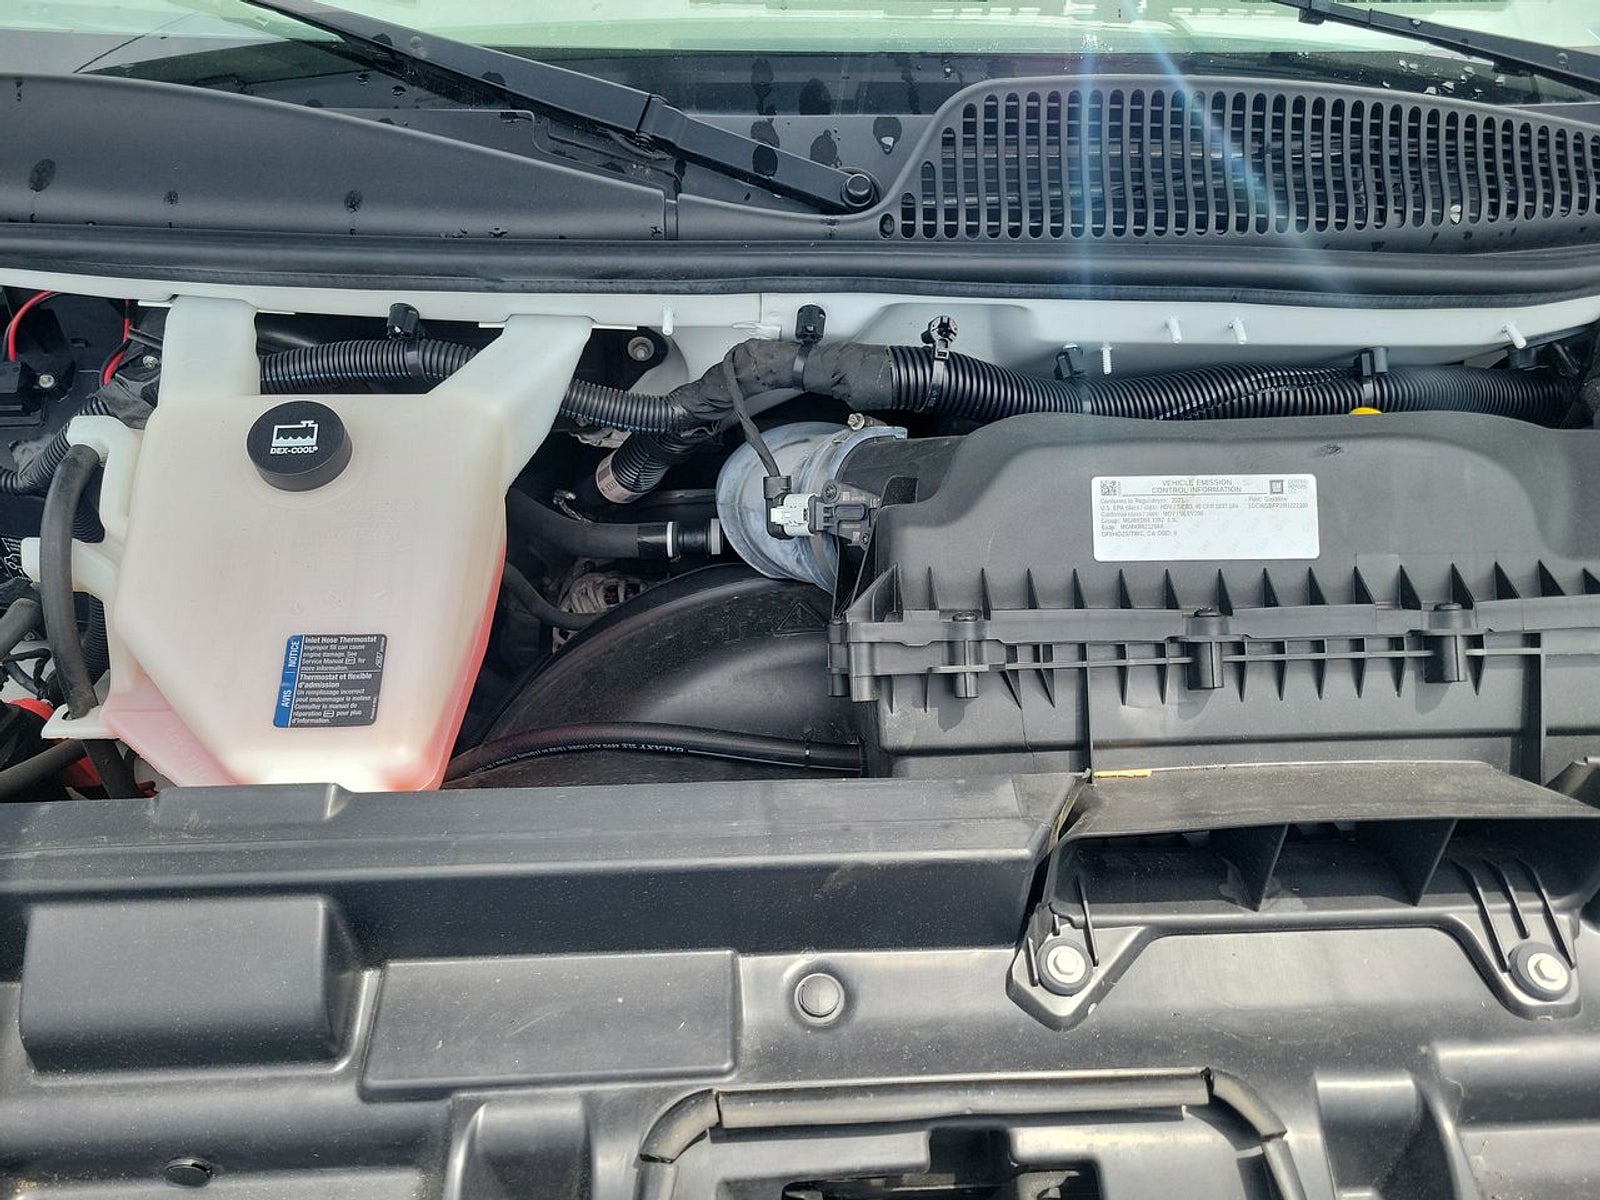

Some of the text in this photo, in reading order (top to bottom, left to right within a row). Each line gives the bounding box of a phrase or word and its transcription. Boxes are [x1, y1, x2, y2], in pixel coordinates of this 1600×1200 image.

[288, 641, 299, 667] NOTICE
[281, 690, 292, 707] AVIS
[638, 744, 684, 752] GALAXY
